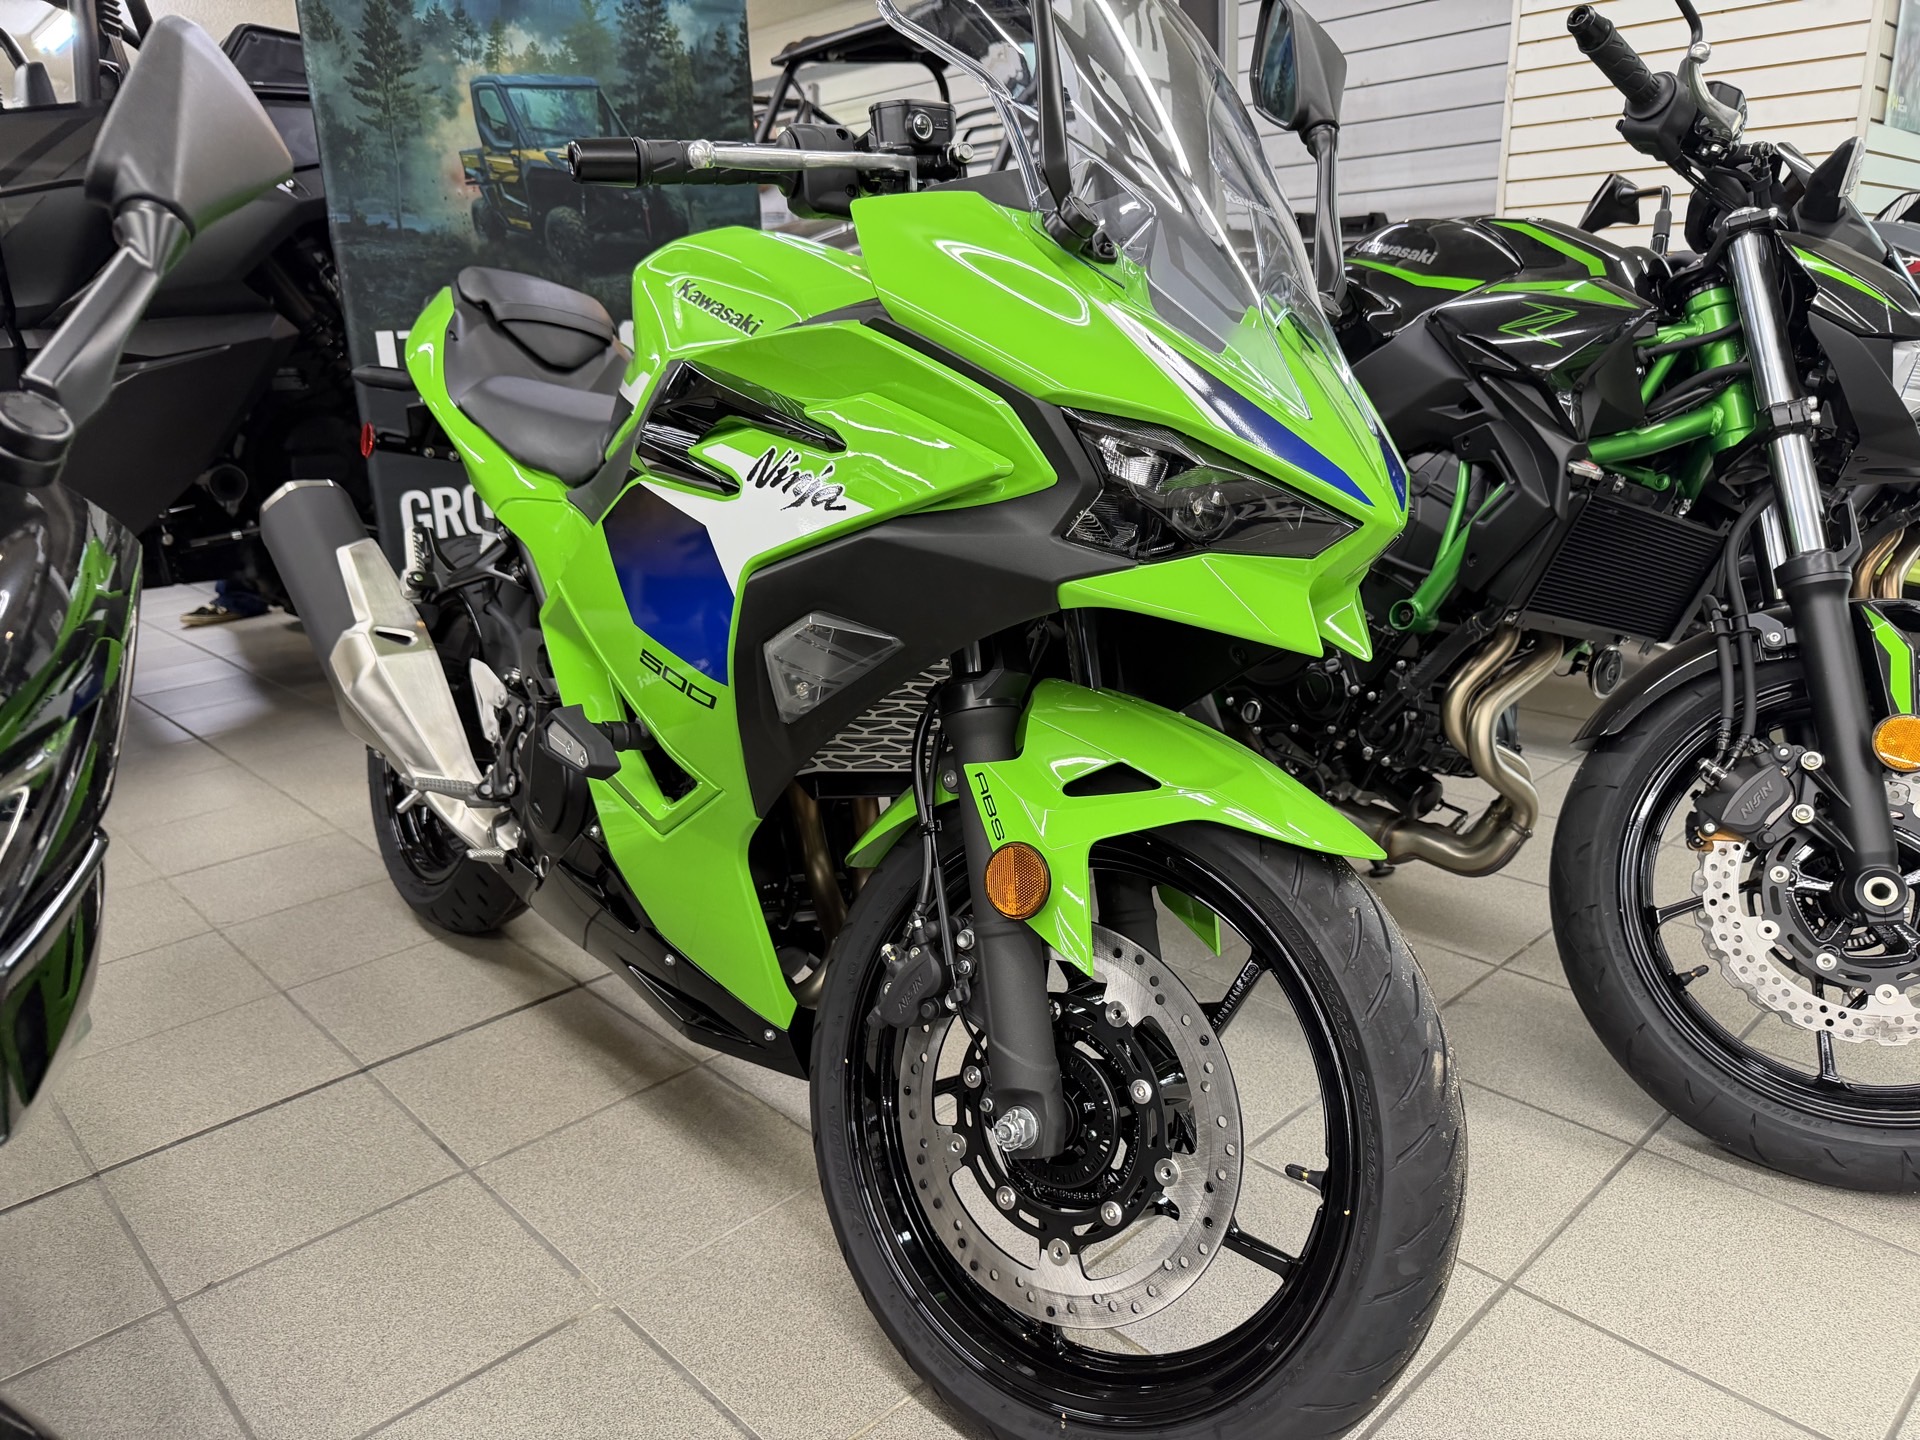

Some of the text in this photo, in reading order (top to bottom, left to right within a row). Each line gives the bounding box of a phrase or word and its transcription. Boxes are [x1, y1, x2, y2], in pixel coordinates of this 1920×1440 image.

[676, 279, 764, 336] Kawasaki
[746, 447, 847, 511] Ninja
[640, 648, 718, 710] 500
[974, 771, 1005, 841] ABS
